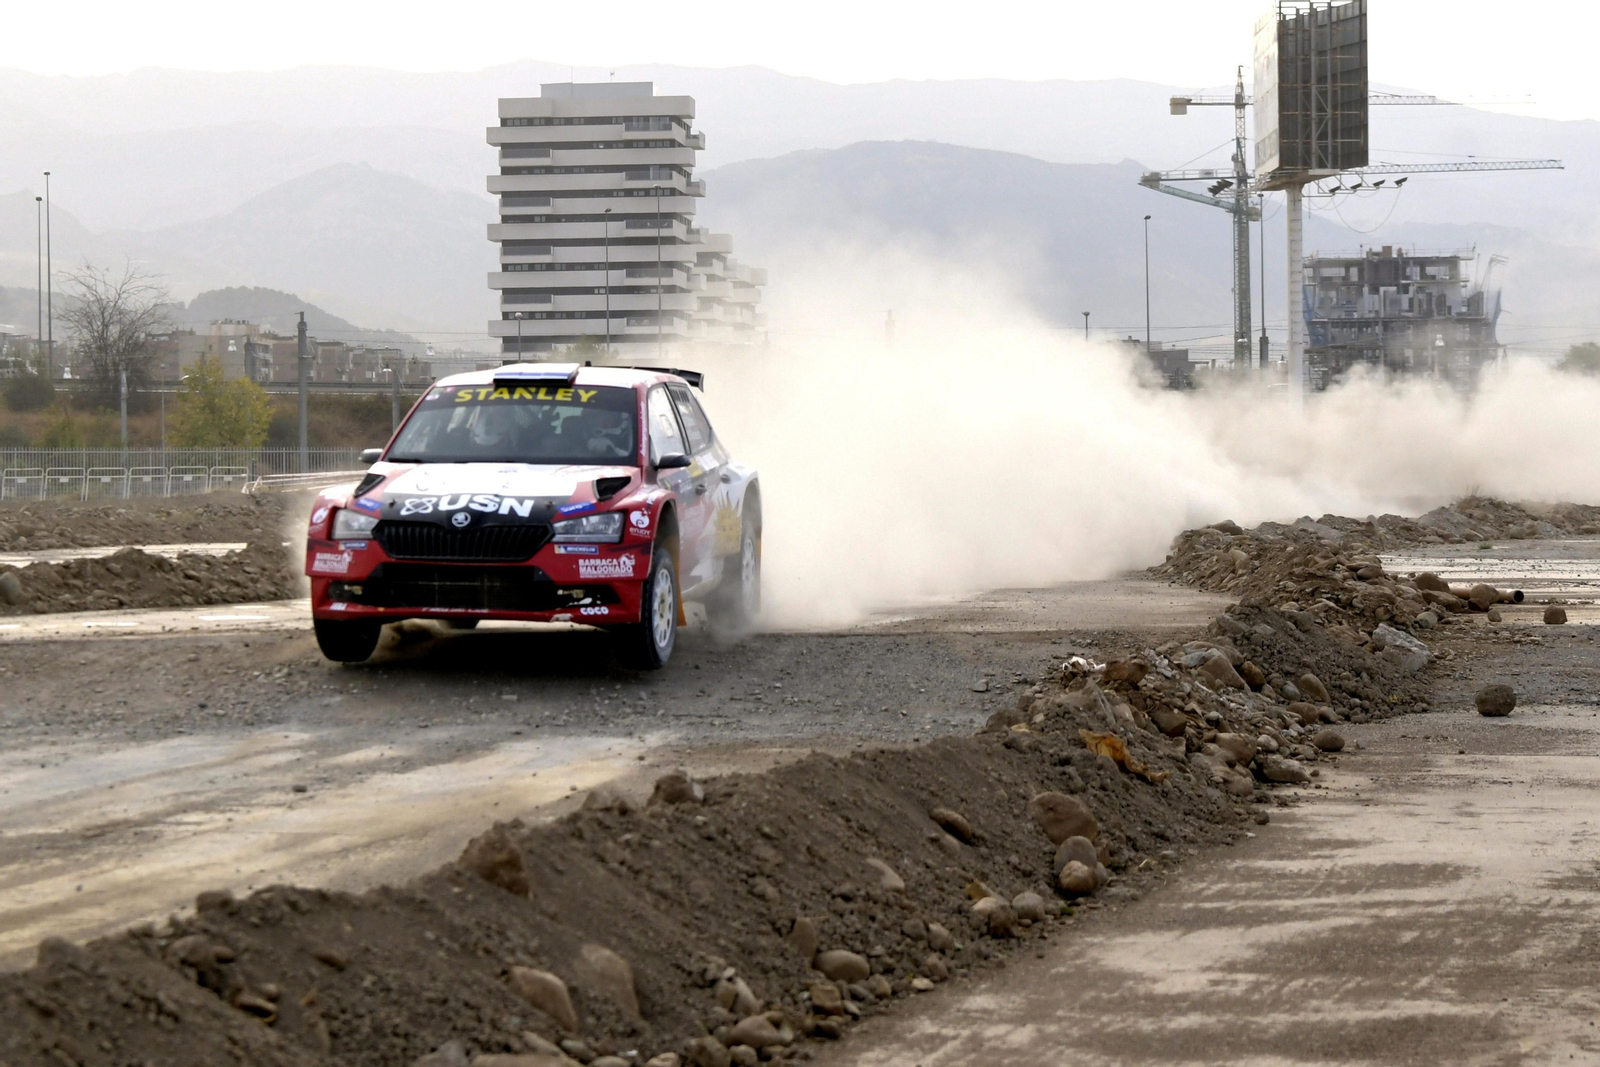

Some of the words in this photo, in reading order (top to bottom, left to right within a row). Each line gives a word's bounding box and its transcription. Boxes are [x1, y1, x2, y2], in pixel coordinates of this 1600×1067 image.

[454, 387, 598, 403] STANLEY
[437, 494, 535, 518] USN
[579, 558, 619, 566] BARRACA
[579, 565, 633, 574] MALDONADO
